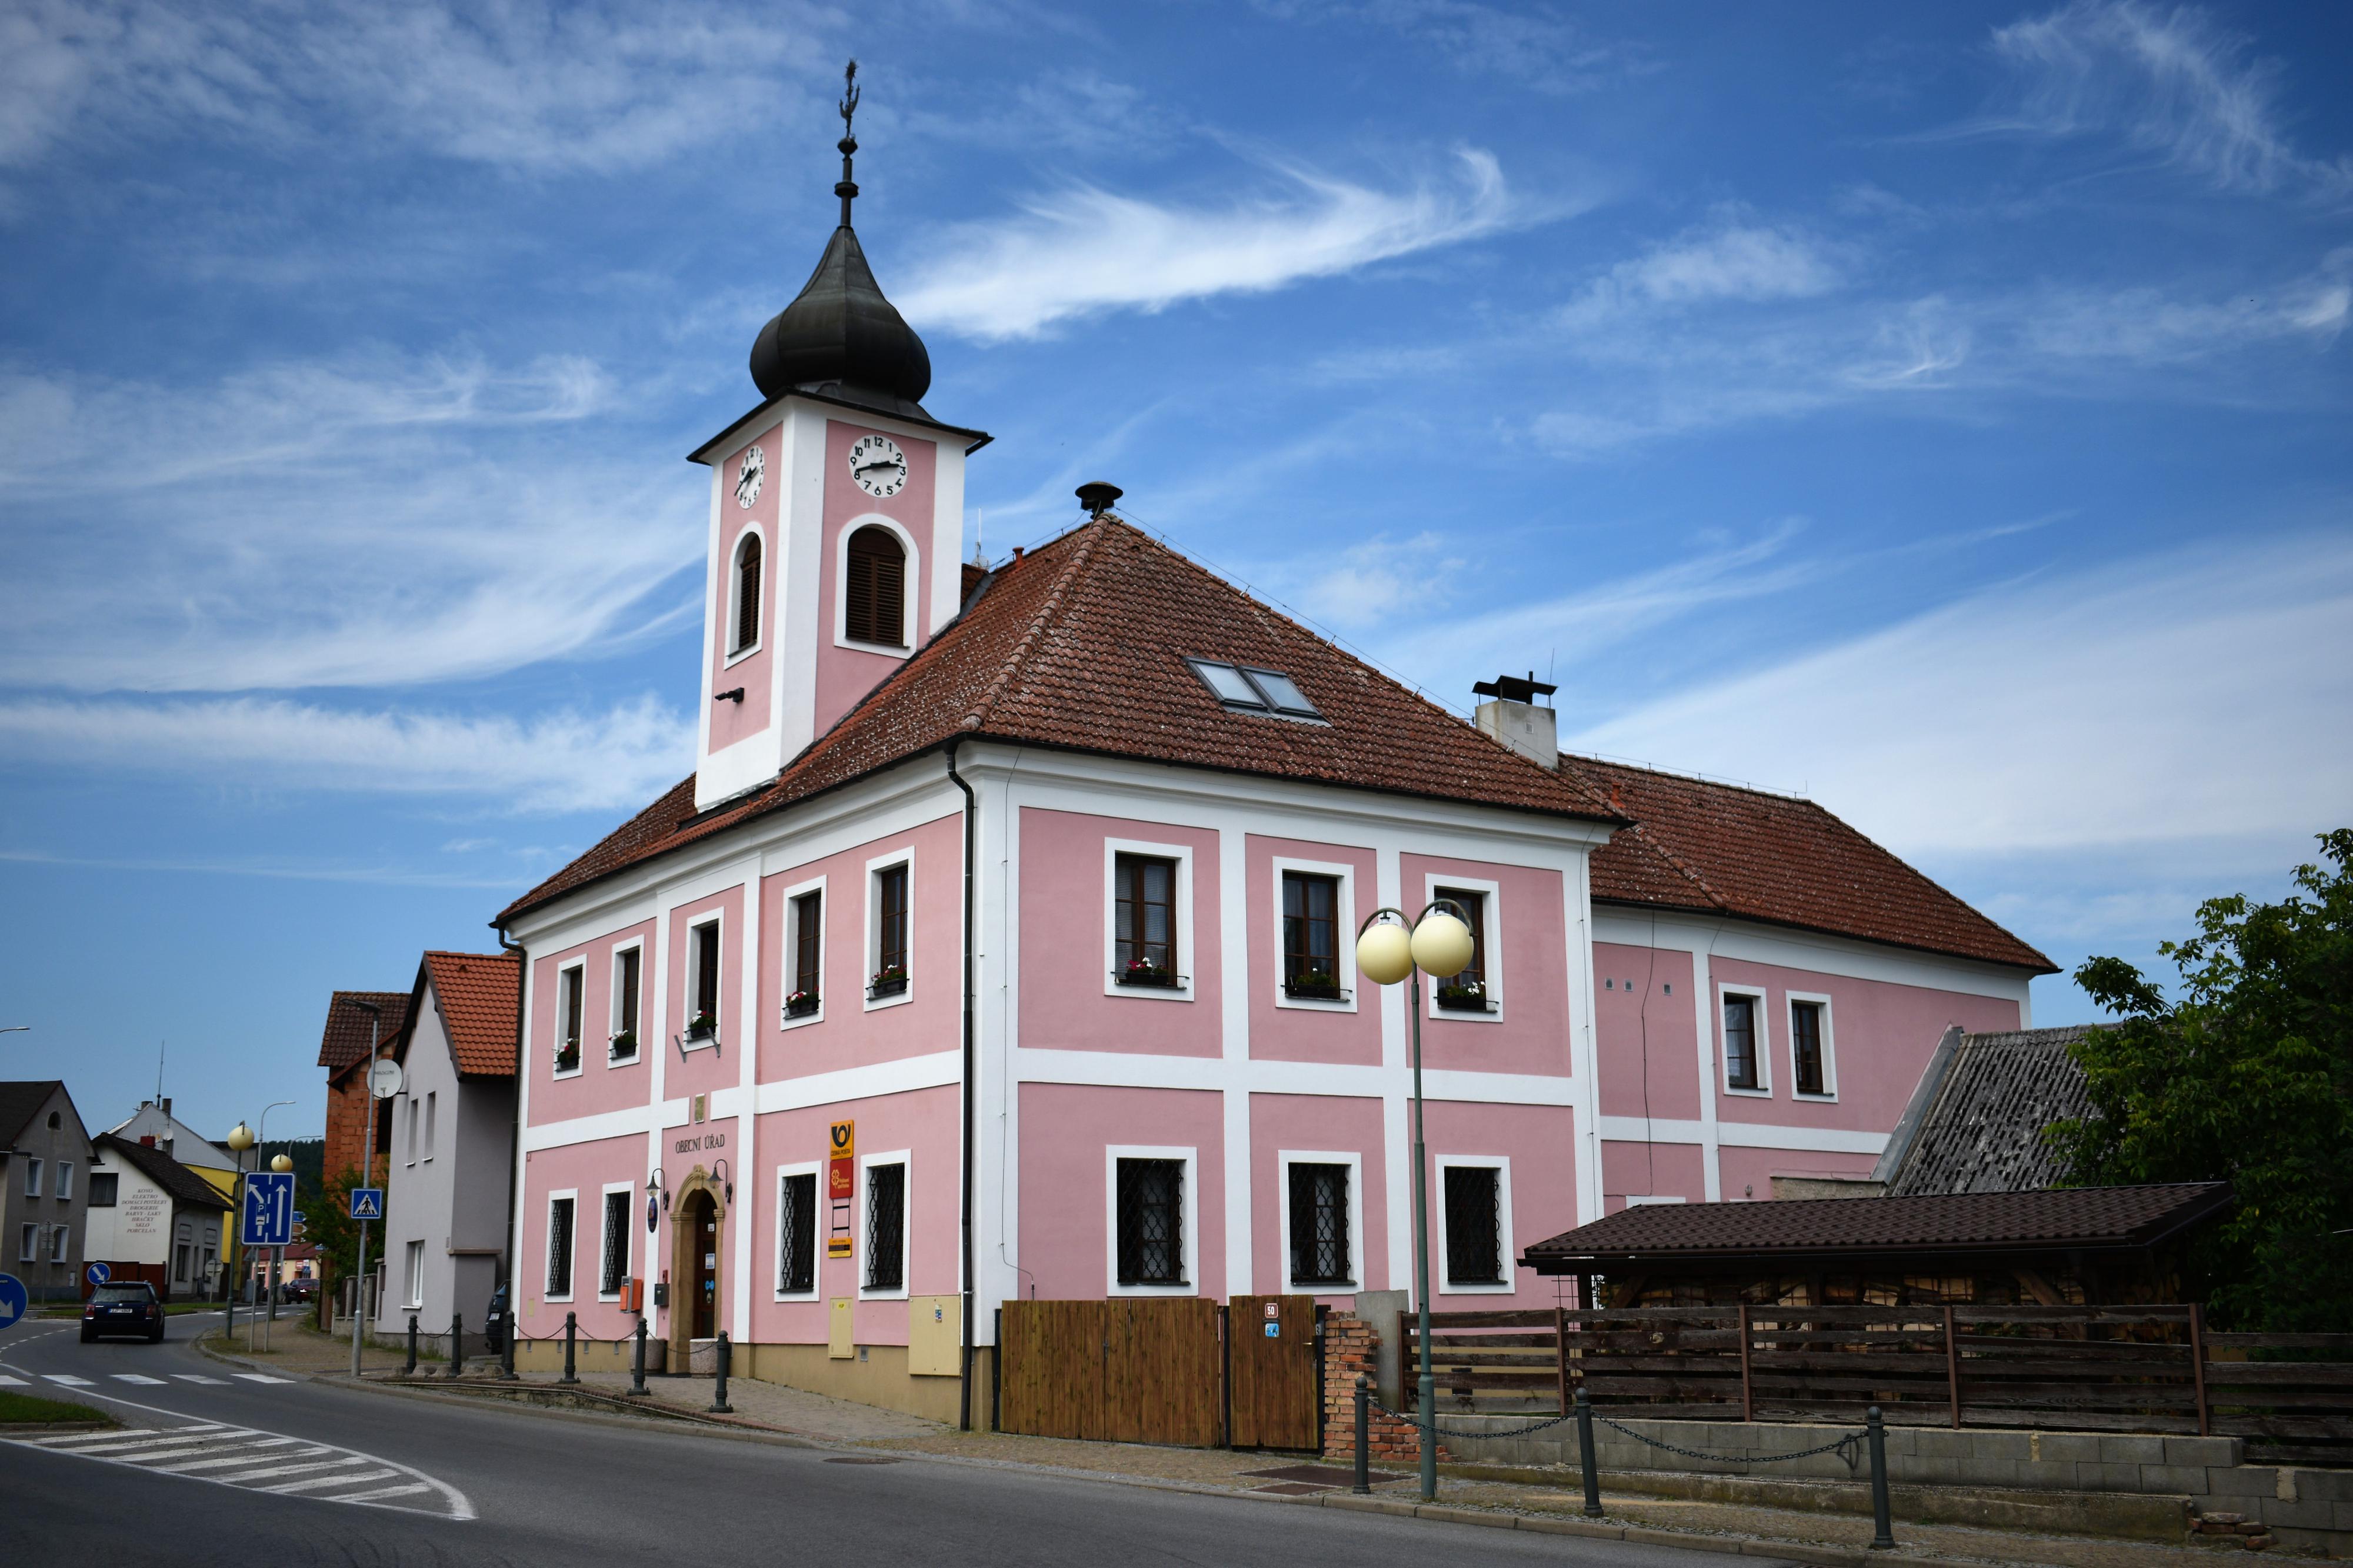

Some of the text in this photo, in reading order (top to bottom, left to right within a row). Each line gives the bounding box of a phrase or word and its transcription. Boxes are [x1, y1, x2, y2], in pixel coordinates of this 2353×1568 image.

[864, 438, 870, 448] 11
[875, 436, 883, 447] 12
[855, 446, 863, 456] 10
[889, 442, 892, 452] 1
[850, 456, 856, 466] 9
[896, 453, 902, 462] 2
[854, 469, 860, 480] 8
[899, 466, 906, 476] 3
[864, 480, 871, 490] 7
[895, 478, 902, 488] 4
[875, 486, 881, 495] 6
[886, 485, 893, 495] 5
[675, 1133, 725, 1154] OBECNÍ ÚŘAD
[1267, 1306, 1275, 1315] 50
